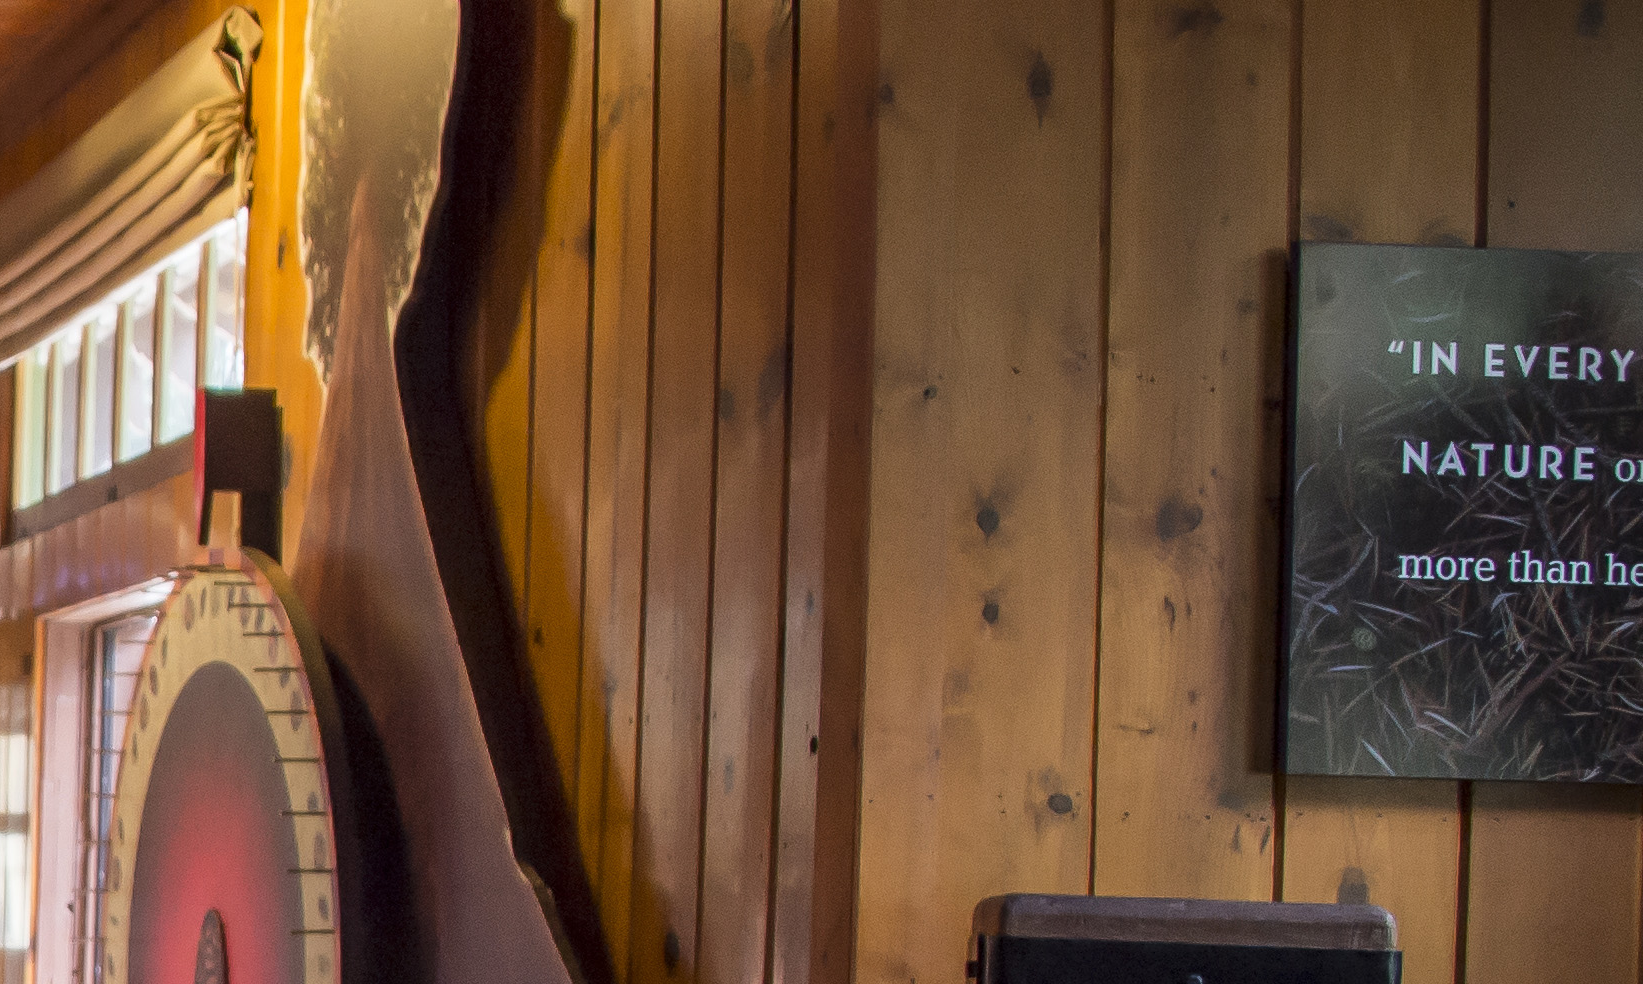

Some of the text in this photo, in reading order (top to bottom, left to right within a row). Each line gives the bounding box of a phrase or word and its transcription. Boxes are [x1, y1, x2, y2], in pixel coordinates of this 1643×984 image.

[1482, 342, 1635, 384] EVERY
[1400, 439, 1598, 482] NATURE
[1397, 553, 1497, 583] more
[1506, 550, 1594, 586] than
